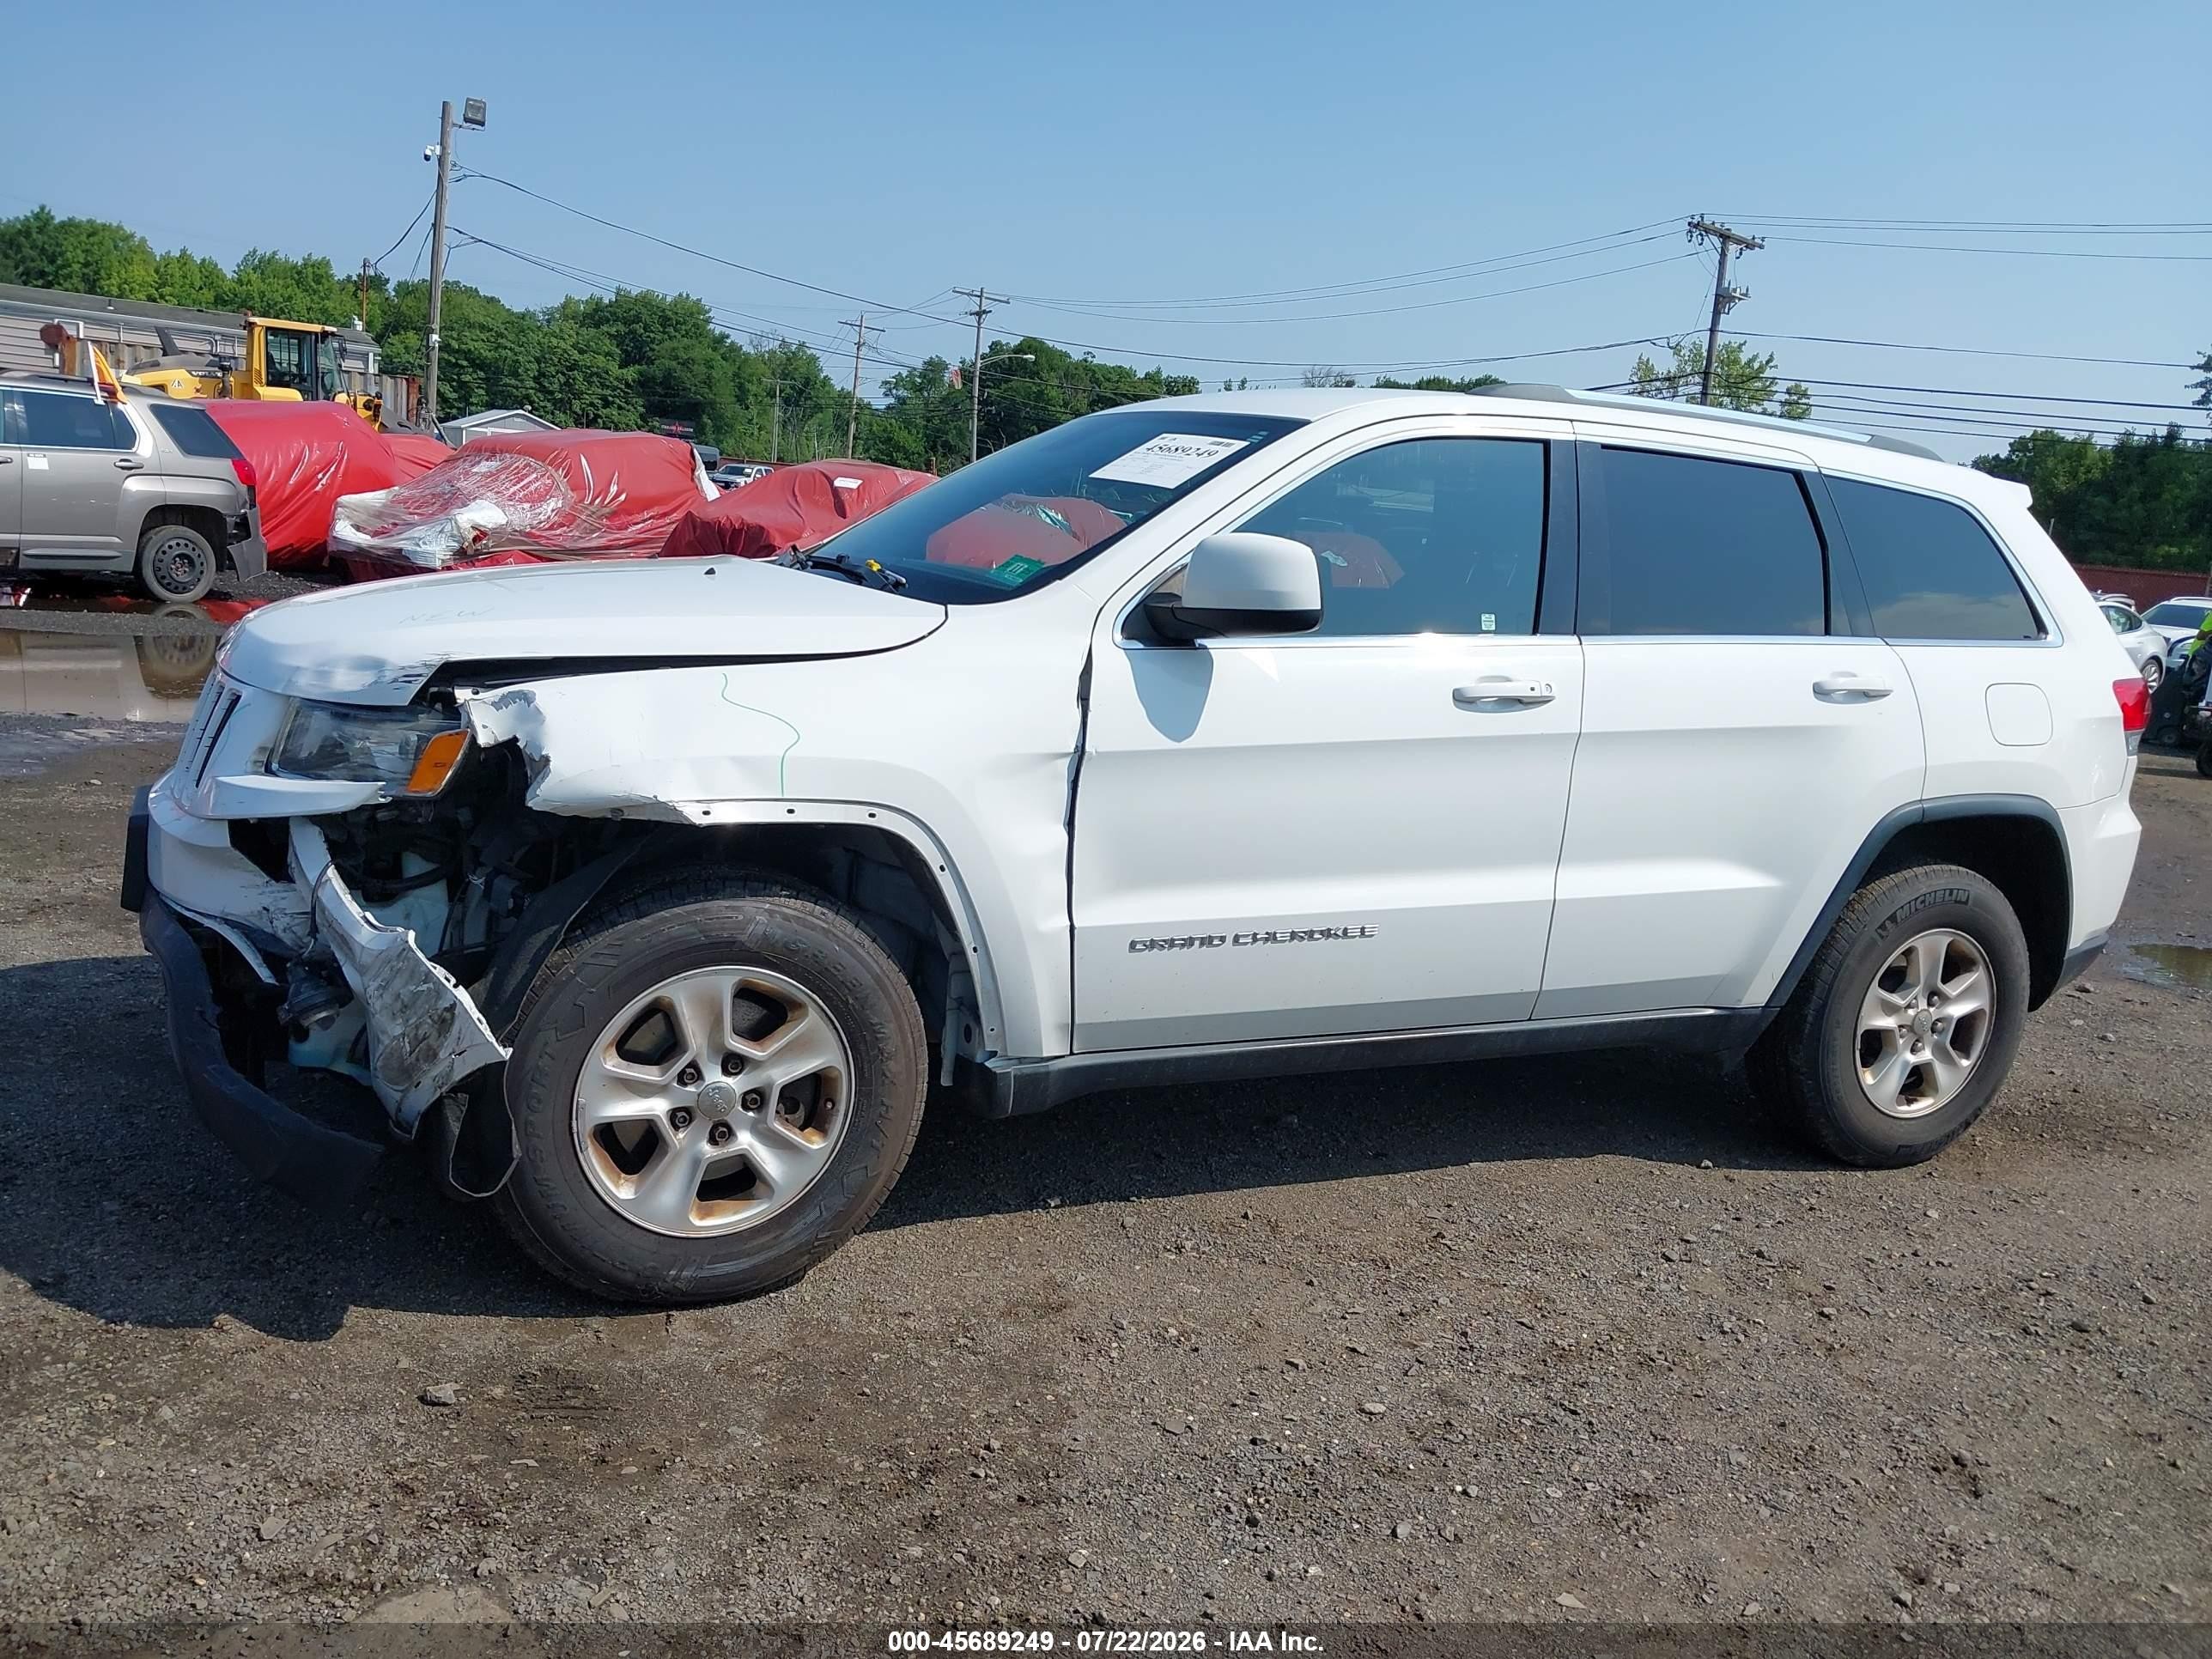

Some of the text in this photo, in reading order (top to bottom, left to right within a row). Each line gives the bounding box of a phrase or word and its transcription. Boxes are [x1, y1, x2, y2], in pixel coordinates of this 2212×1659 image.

[1146, 443, 1220, 459] 45689249
[1895, 888, 1970, 923] MICHELIN
[1128, 924, 1380, 953] GRAND CHEROKEE
